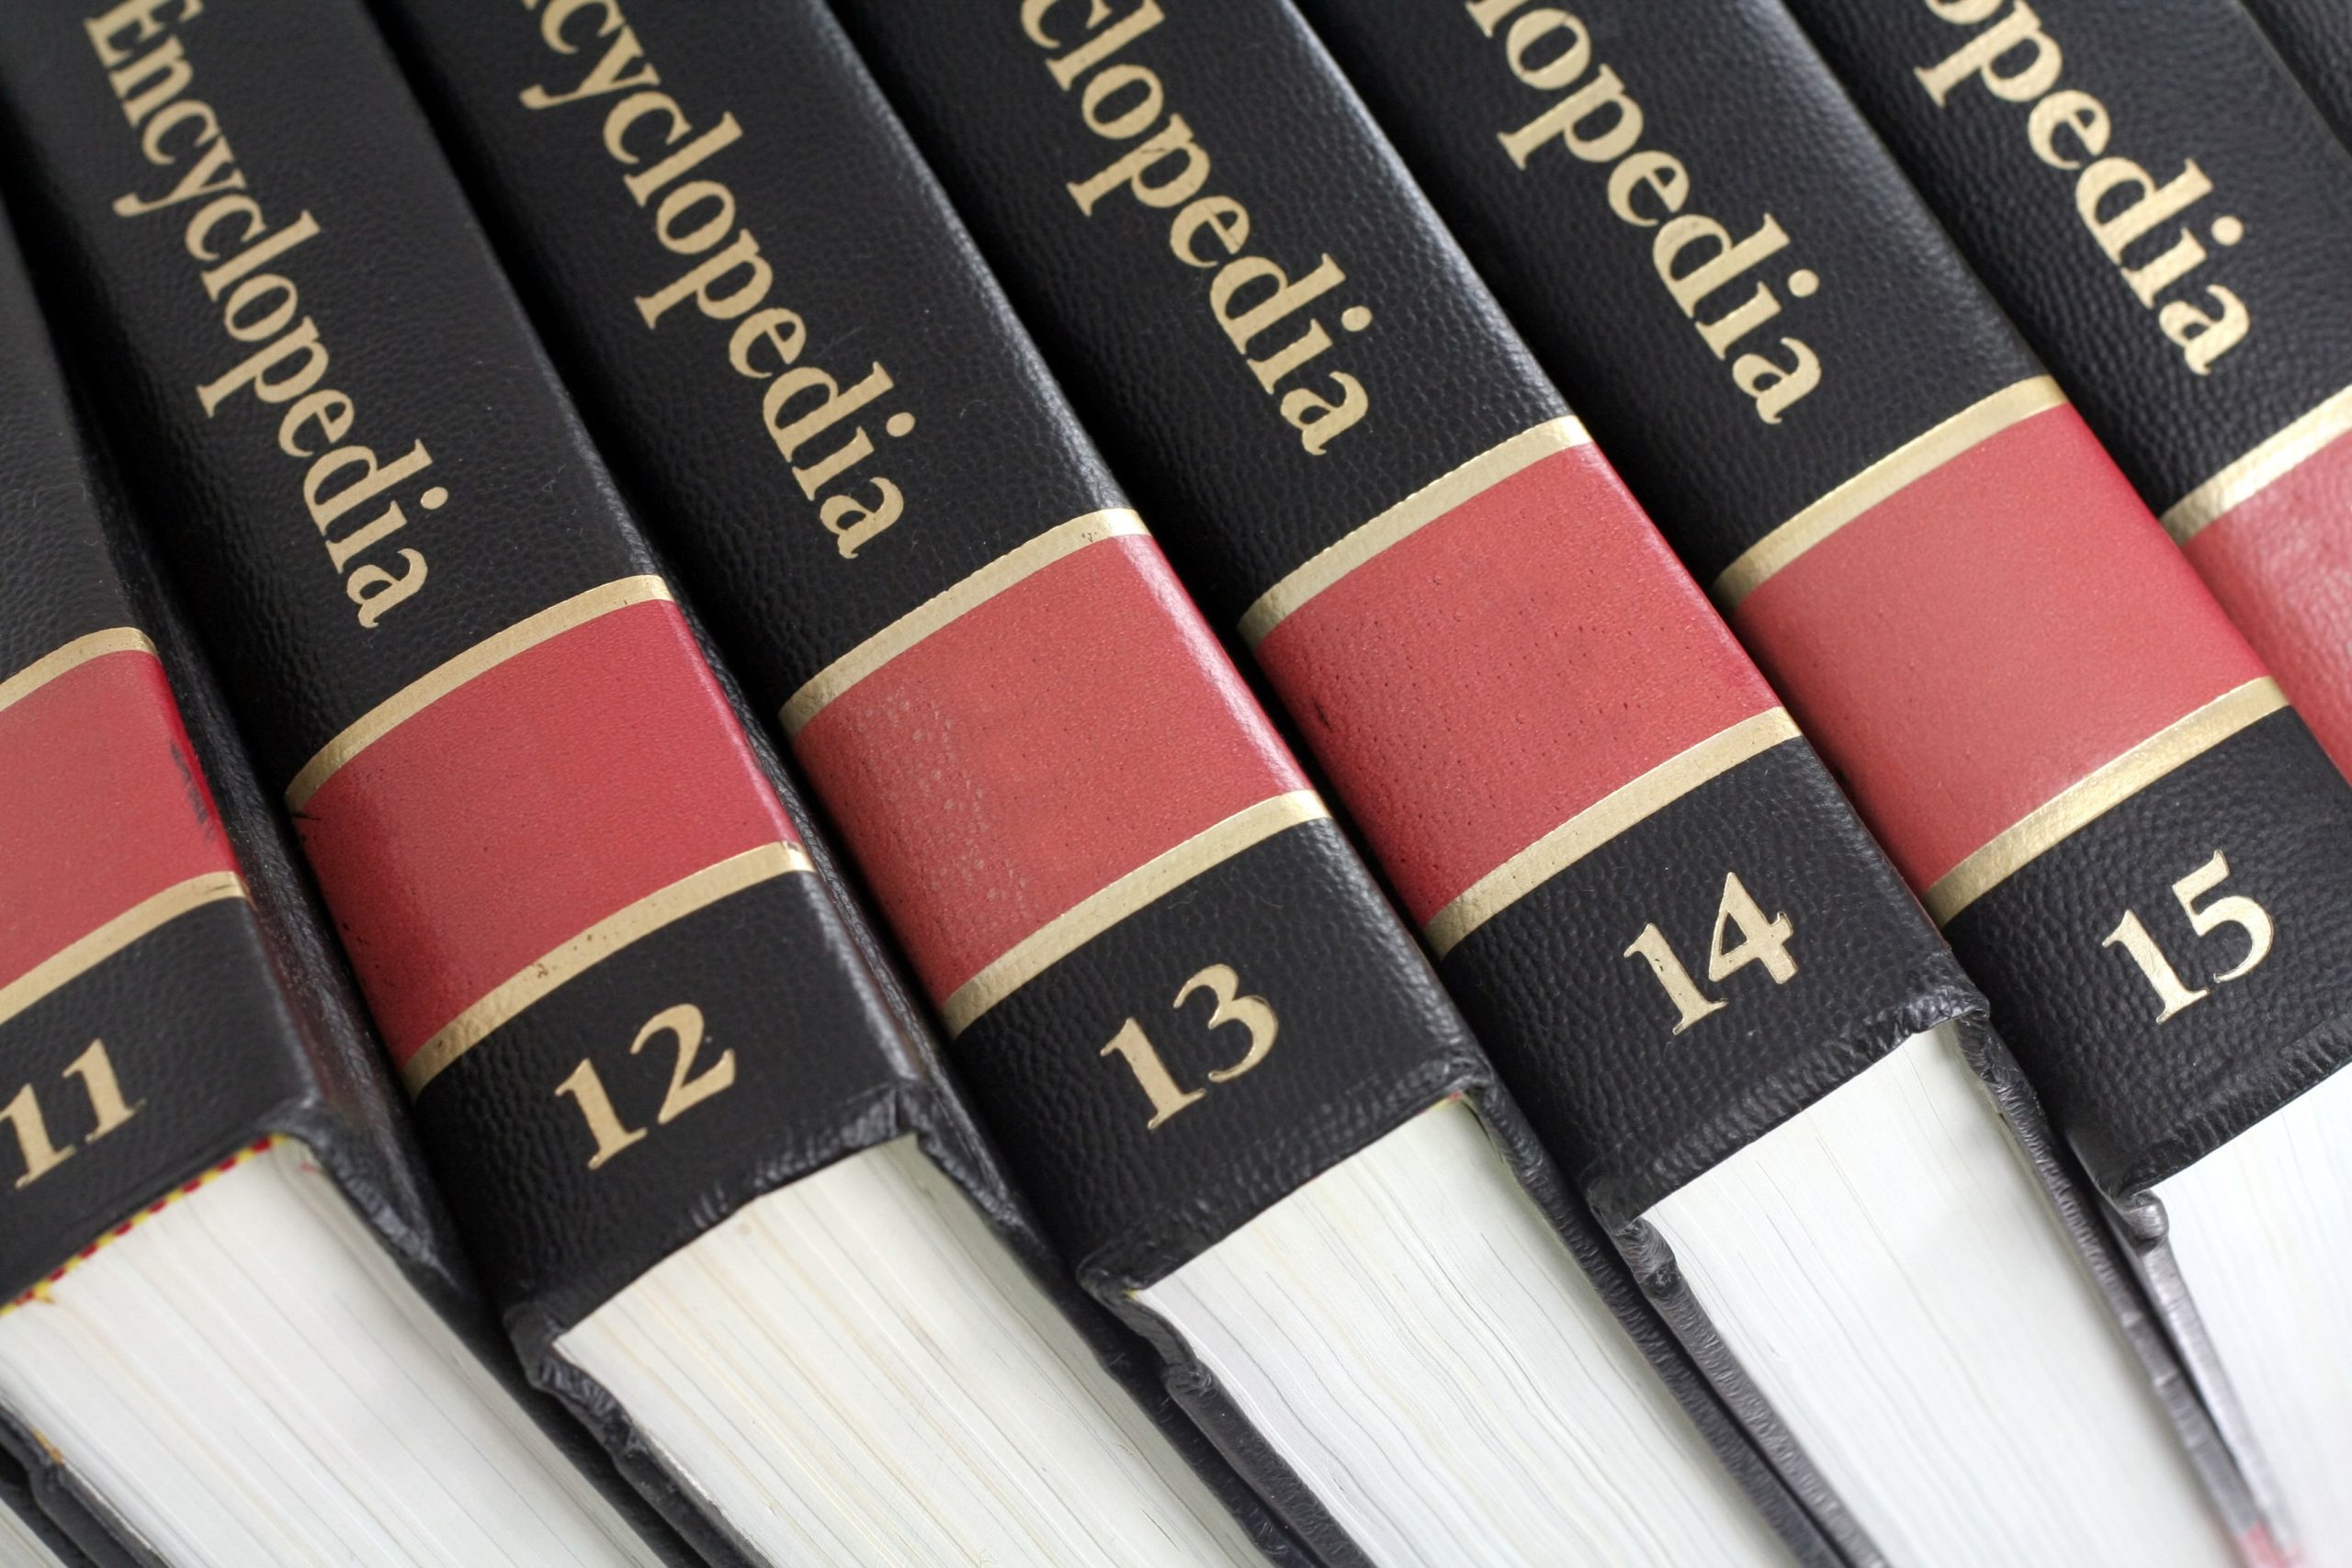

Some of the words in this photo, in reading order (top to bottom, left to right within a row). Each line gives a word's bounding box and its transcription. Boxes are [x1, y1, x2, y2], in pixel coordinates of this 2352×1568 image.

[1914, 0, 2251, 376] pedia
[85, 0, 449, 629] Encyclopedia
[519, 0, 916, 559] cyclopedia
[1624, 871, 1799, 1035] 14
[2101, 851, 2276, 1024] 15
[0, 1038, 147, 1190] 11
[554, 1003, 736, 1170] 12
[1099, 963, 1280, 1131] 13
